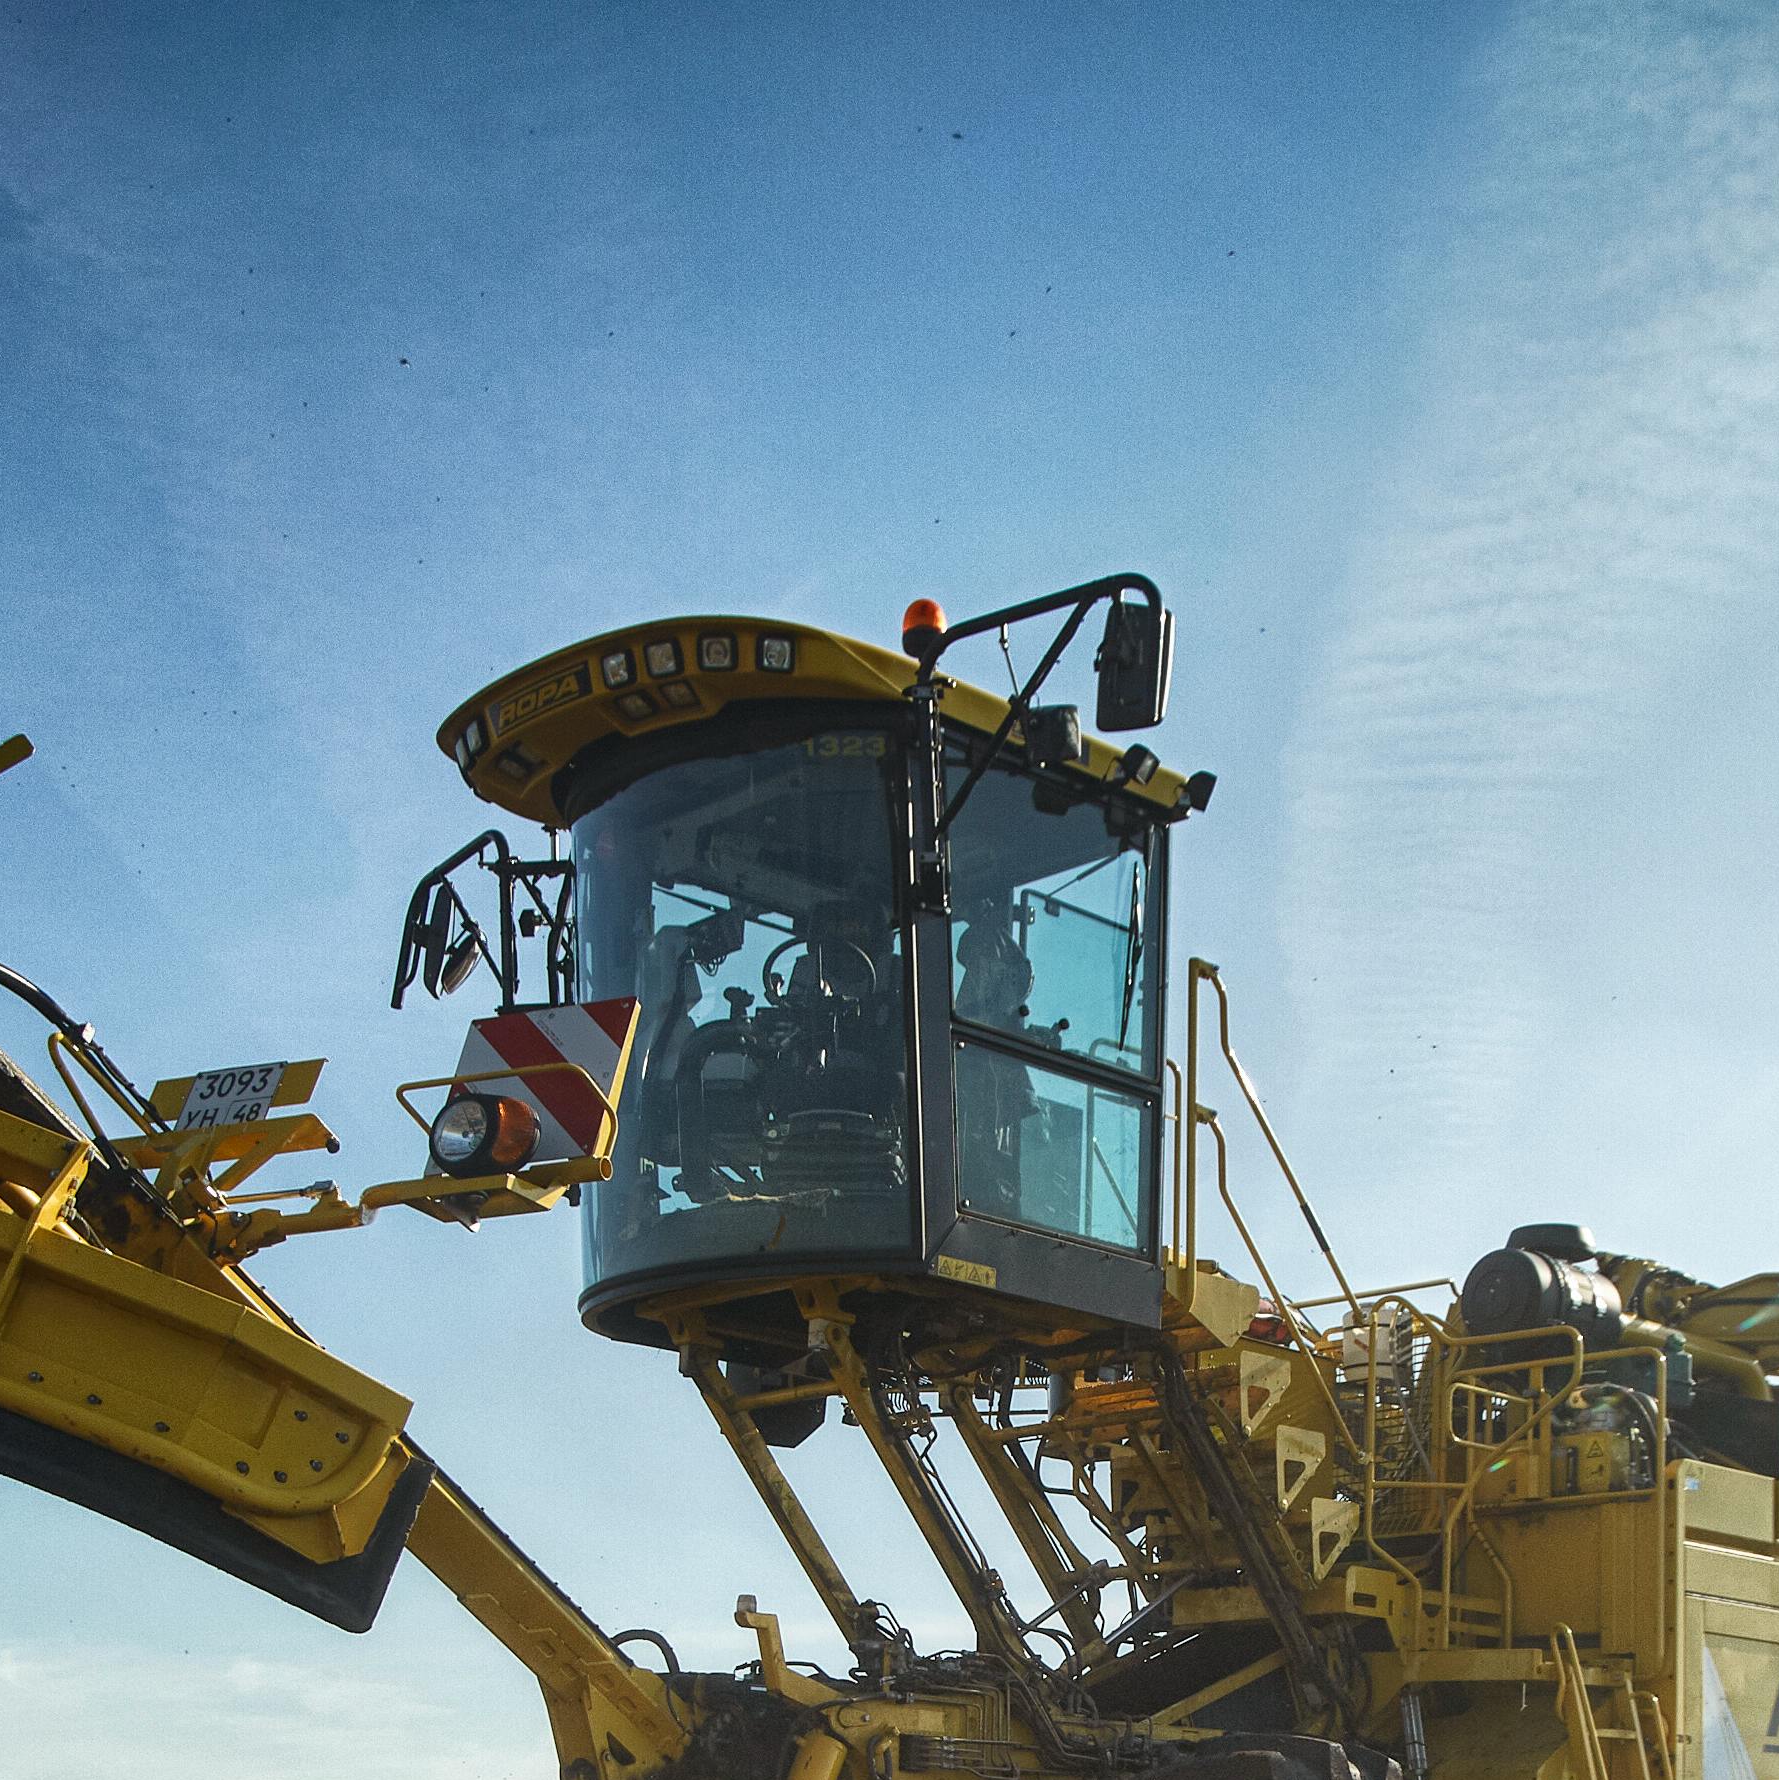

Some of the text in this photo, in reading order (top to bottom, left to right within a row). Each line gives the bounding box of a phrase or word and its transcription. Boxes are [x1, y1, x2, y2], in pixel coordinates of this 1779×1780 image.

[499, 673, 580, 729] ROPA
[801, 735, 887, 758] 1323
[199, 1067, 274, 1100] 3093
[233, 1102, 262, 1123] 48
